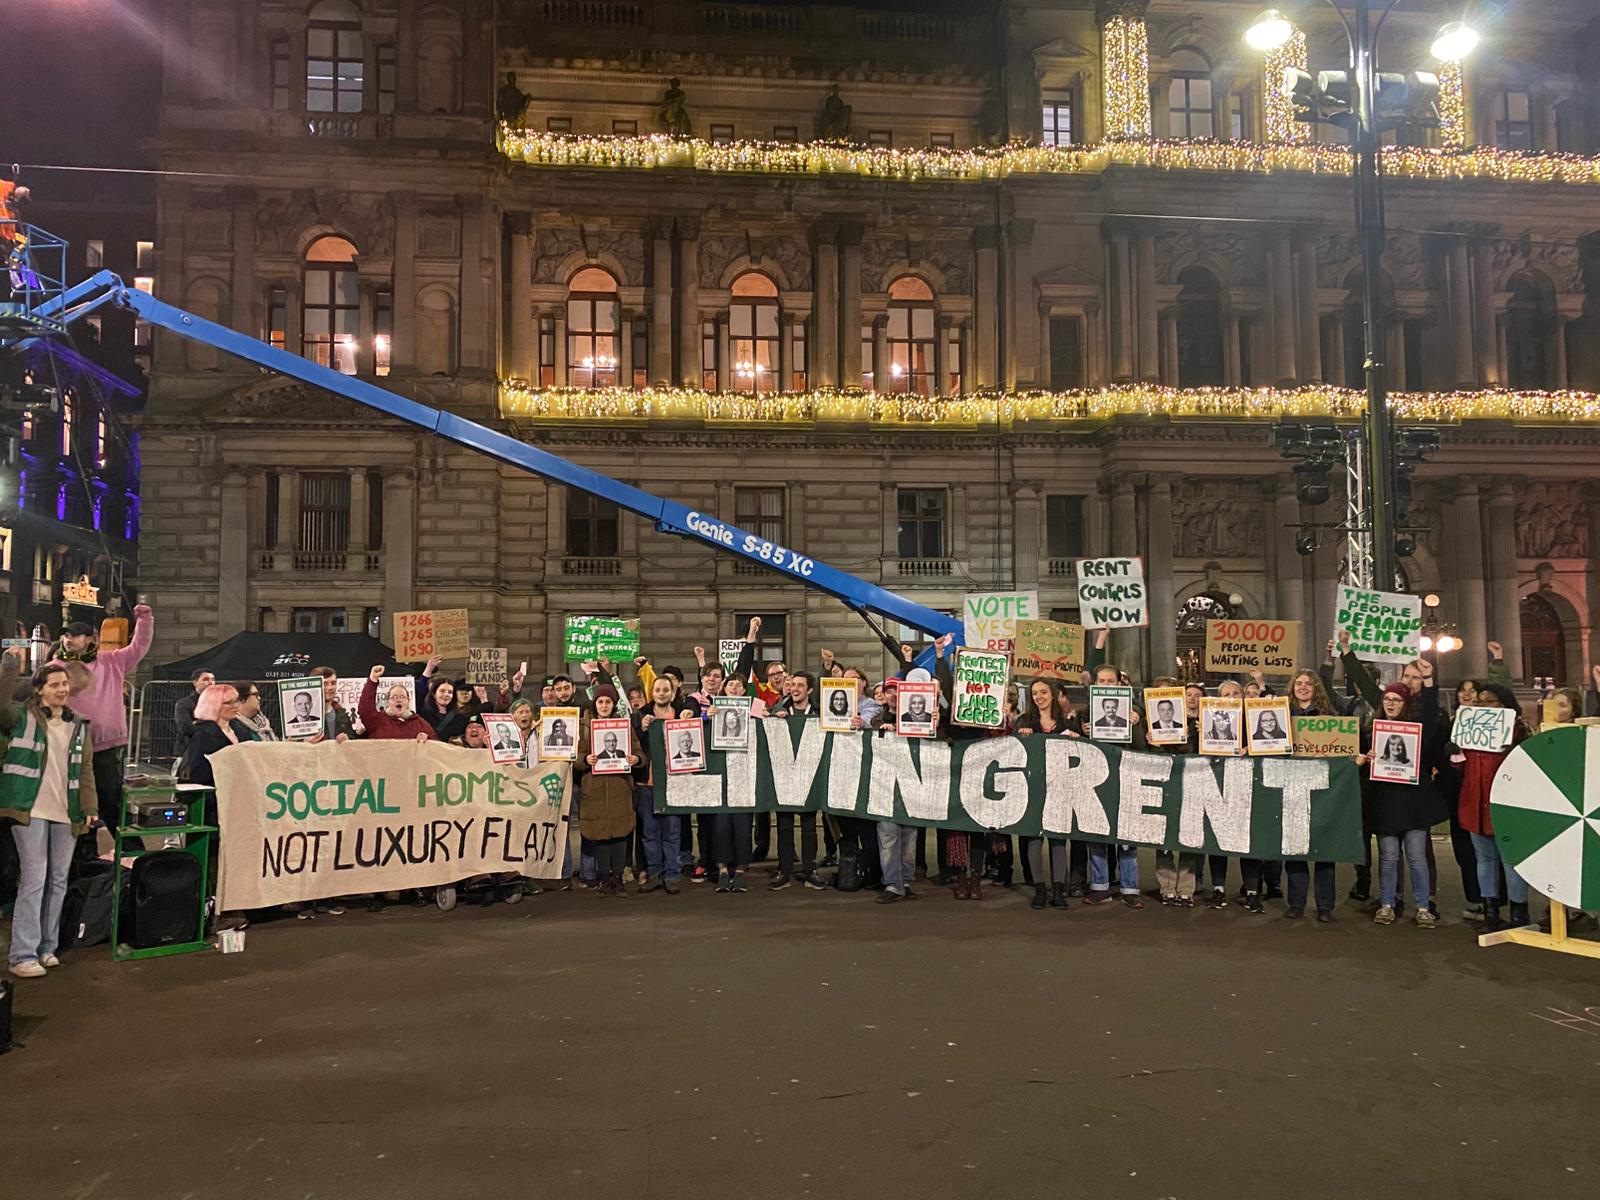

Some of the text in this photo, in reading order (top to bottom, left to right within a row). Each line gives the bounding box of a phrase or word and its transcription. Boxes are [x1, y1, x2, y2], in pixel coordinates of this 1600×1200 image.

[686, 511, 813, 576] Genie S-85 XC
[1083, 560, 1131, 577] RENT
[1080, 583, 1142, 602] CONTROLS
[1344, 588, 1381, 604] THE
[968, 596, 1029, 618] VOTE
[1091, 606, 1140, 624] NOW
[1348, 600, 1411, 617] PEOPLE
[1338, 609, 1422, 631] DEMAND
[402, 628, 433, 642] 2765
[975, 619, 1016, 639] YES
[1345, 625, 1409, 643] RENT
[571, 633, 592, 644] FOR
[987, 640, 1016, 651] REN
[404, 643, 433, 657] 1590
[469, 649, 499, 660] NO TO
[568, 644, 595, 655] RENT
[1221, 642, 1278, 653] PEOPLE ON
[958, 655, 1006, 670] PROTECT
[476, 673, 506, 683] LANDS
[966, 681, 990, 694] NOT
[960, 694, 998, 709] LAND
[957, 706, 1000, 725] LORDS
[1459, 708, 1504, 734] GIZZA
[1296, 719, 1358, 734] PEOPLE
[1293, 743, 1355, 754] DEVELOPERS
[664, 717, 1330, 856] LIVING RENT
[265, 771, 538, 821] SOCIAL HOMES
[262, 815, 562, 878] NOT LUXURY FLATS
